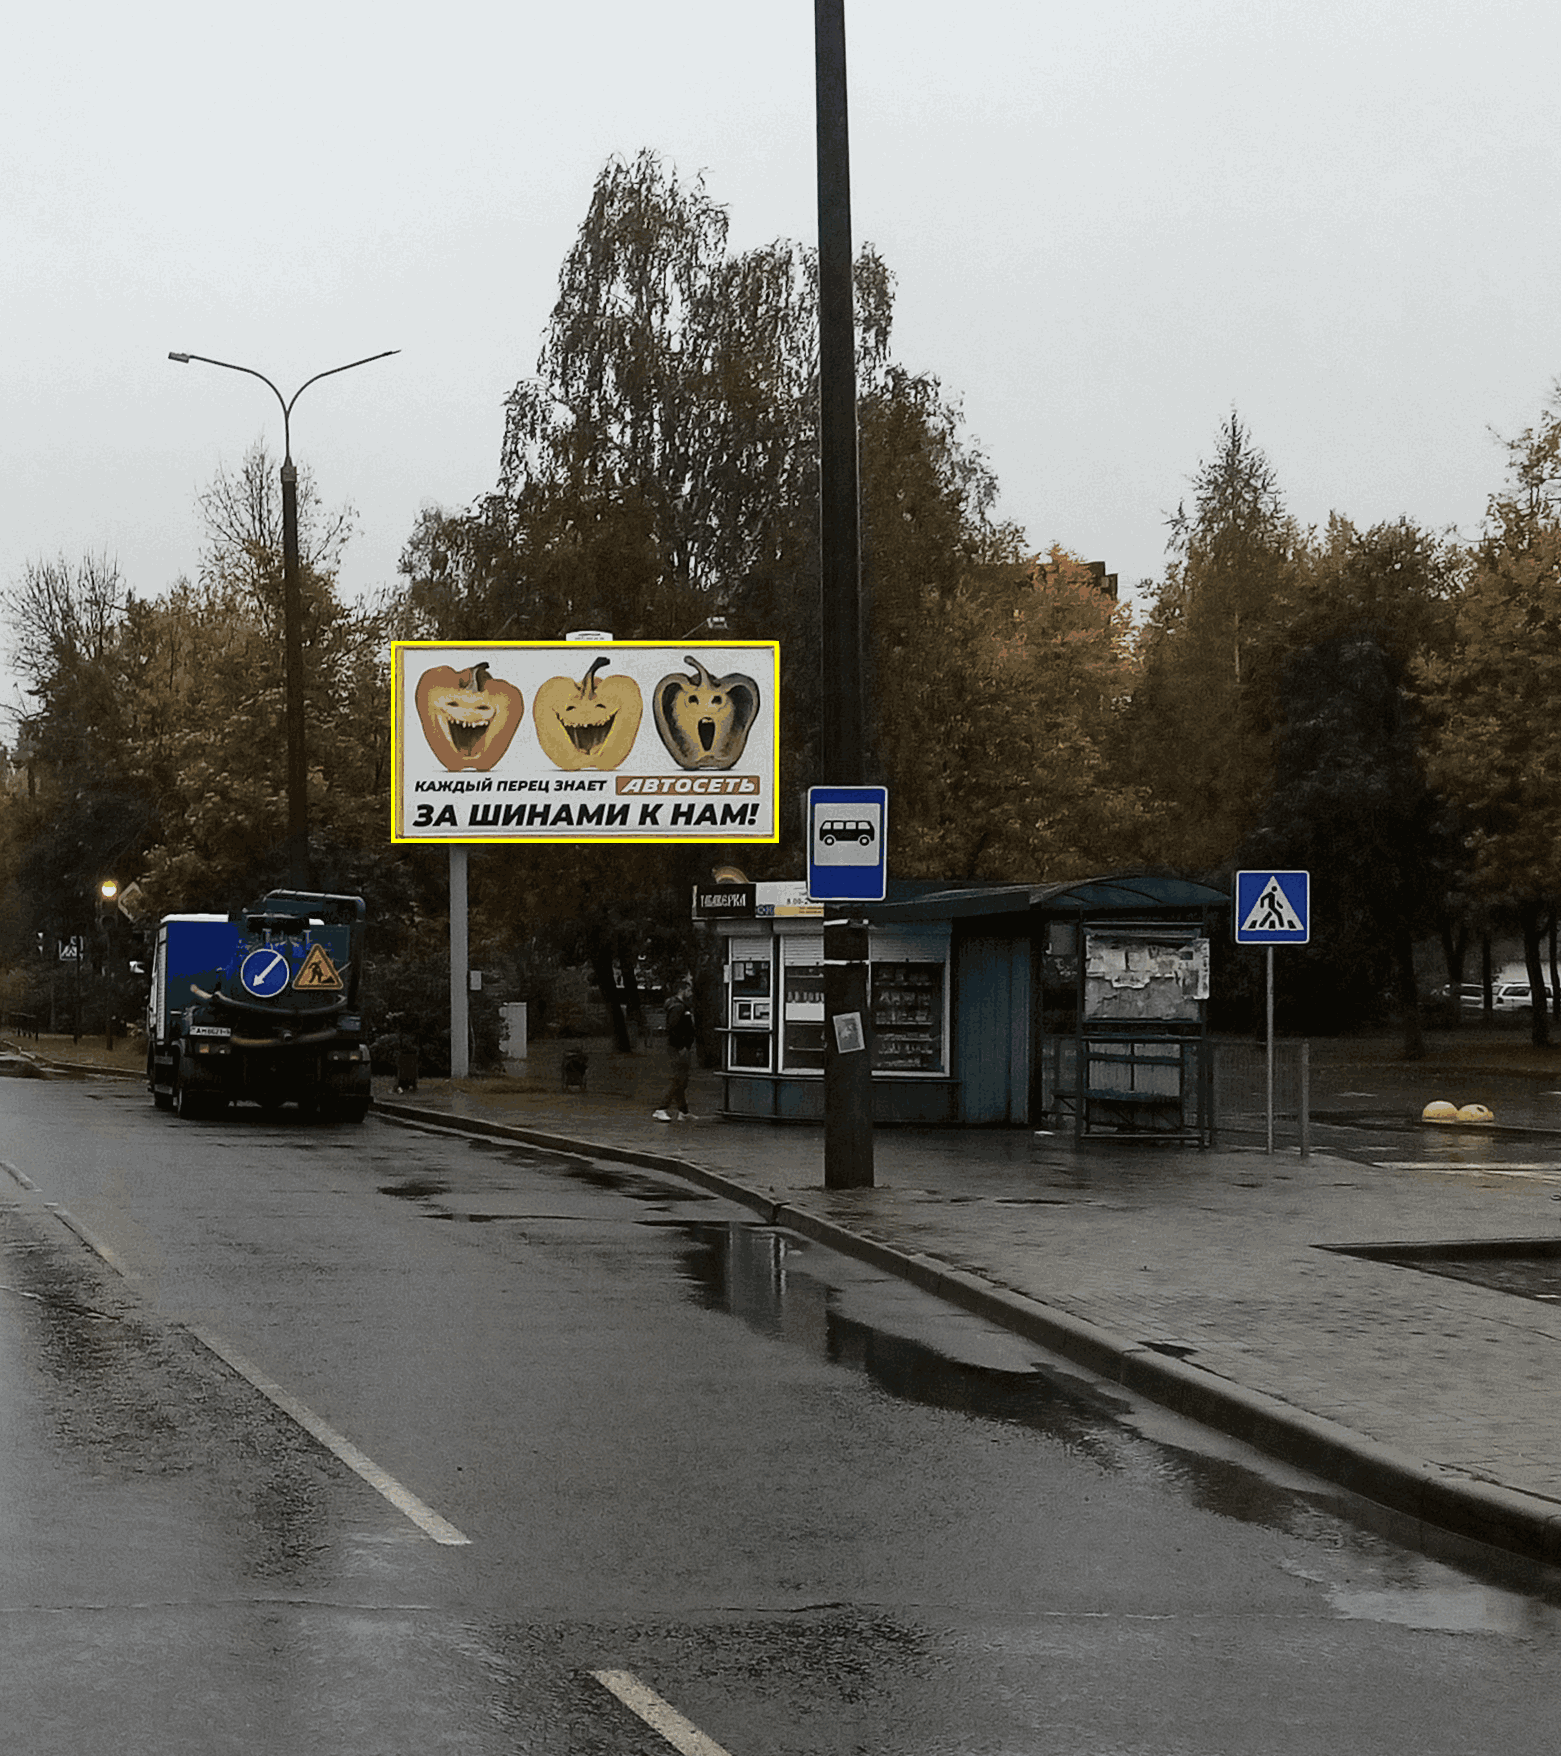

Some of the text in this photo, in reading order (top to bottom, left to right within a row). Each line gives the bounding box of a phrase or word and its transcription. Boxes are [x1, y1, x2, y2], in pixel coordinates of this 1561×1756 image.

[414, 777, 756, 793] КАЖДЫЙ ПЕРЕЦ ЗНАЕТ АВТОСЕТЬ
[412, 803, 760, 827] ЗА ШИНАМИ К НАМ!
